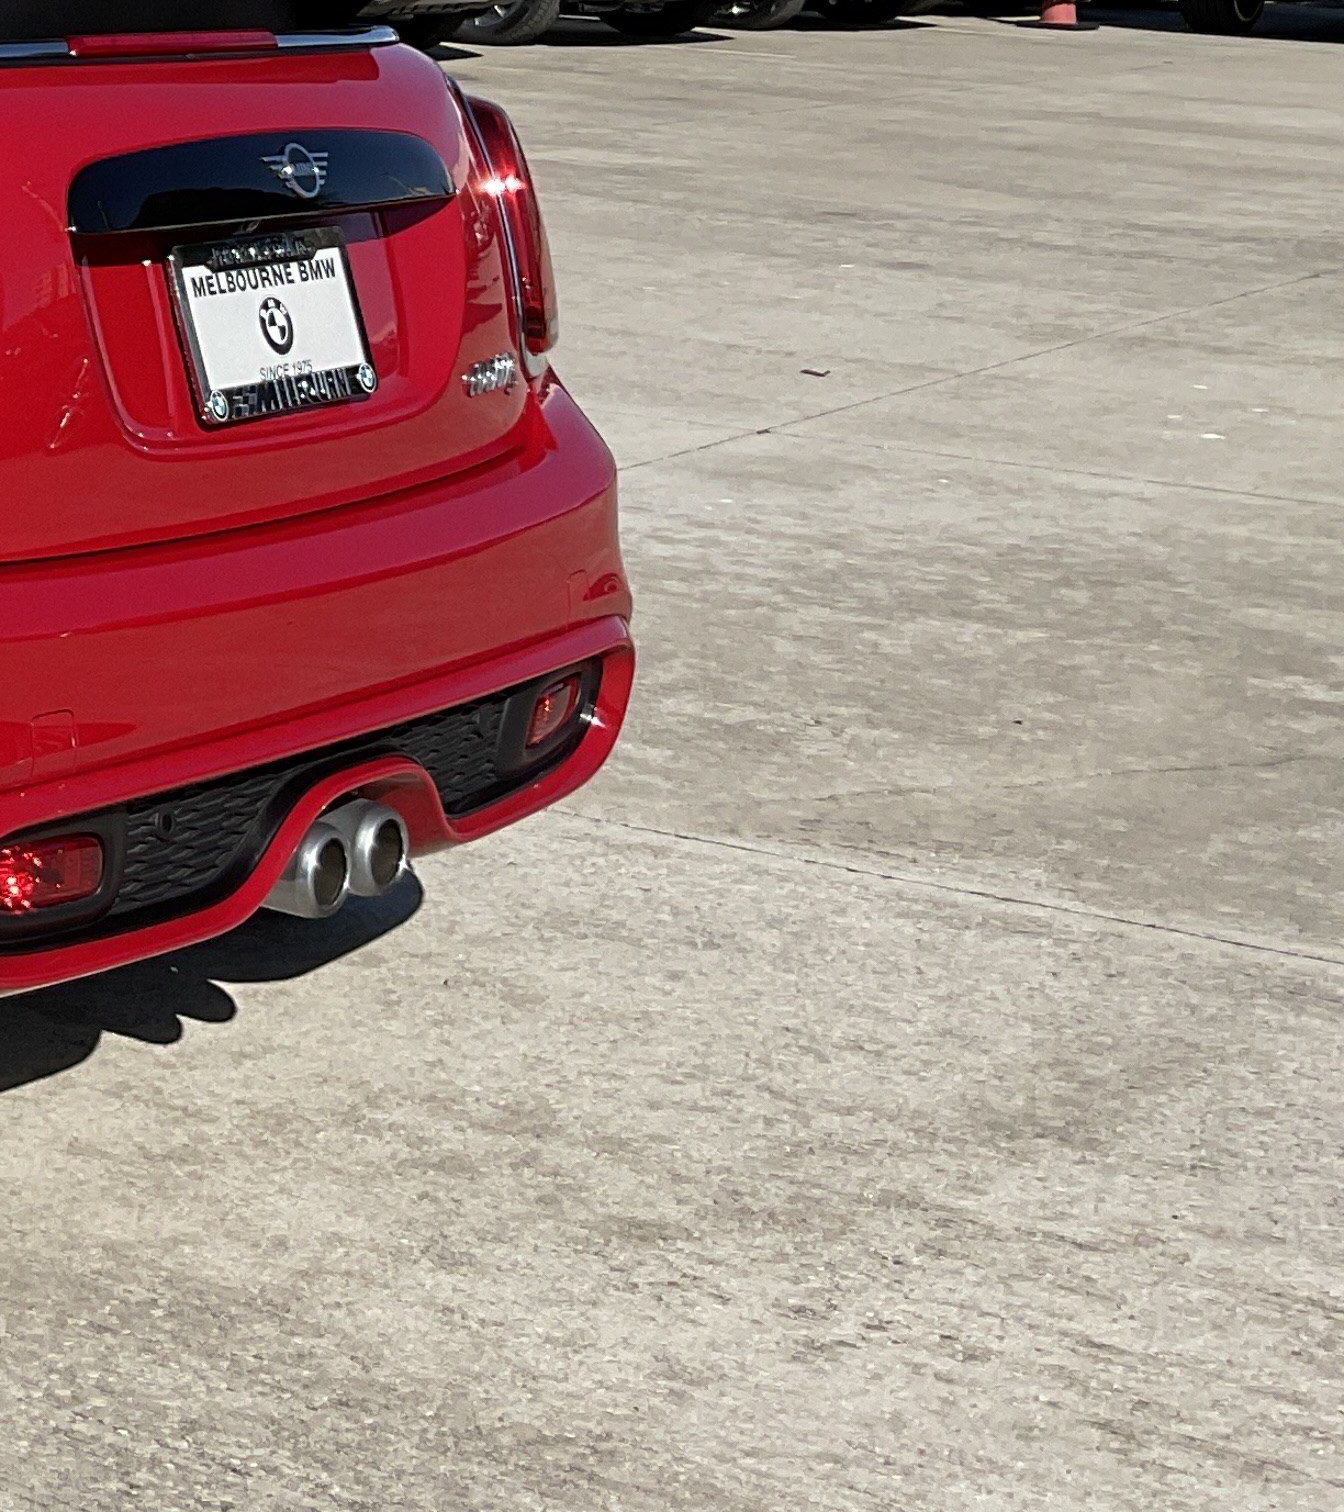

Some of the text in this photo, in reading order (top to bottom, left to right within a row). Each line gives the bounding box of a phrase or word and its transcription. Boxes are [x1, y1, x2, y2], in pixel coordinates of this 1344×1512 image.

[190, 257, 336, 298] MELBOURNE BMW
[259, 359, 313, 380] SINCE 1975
